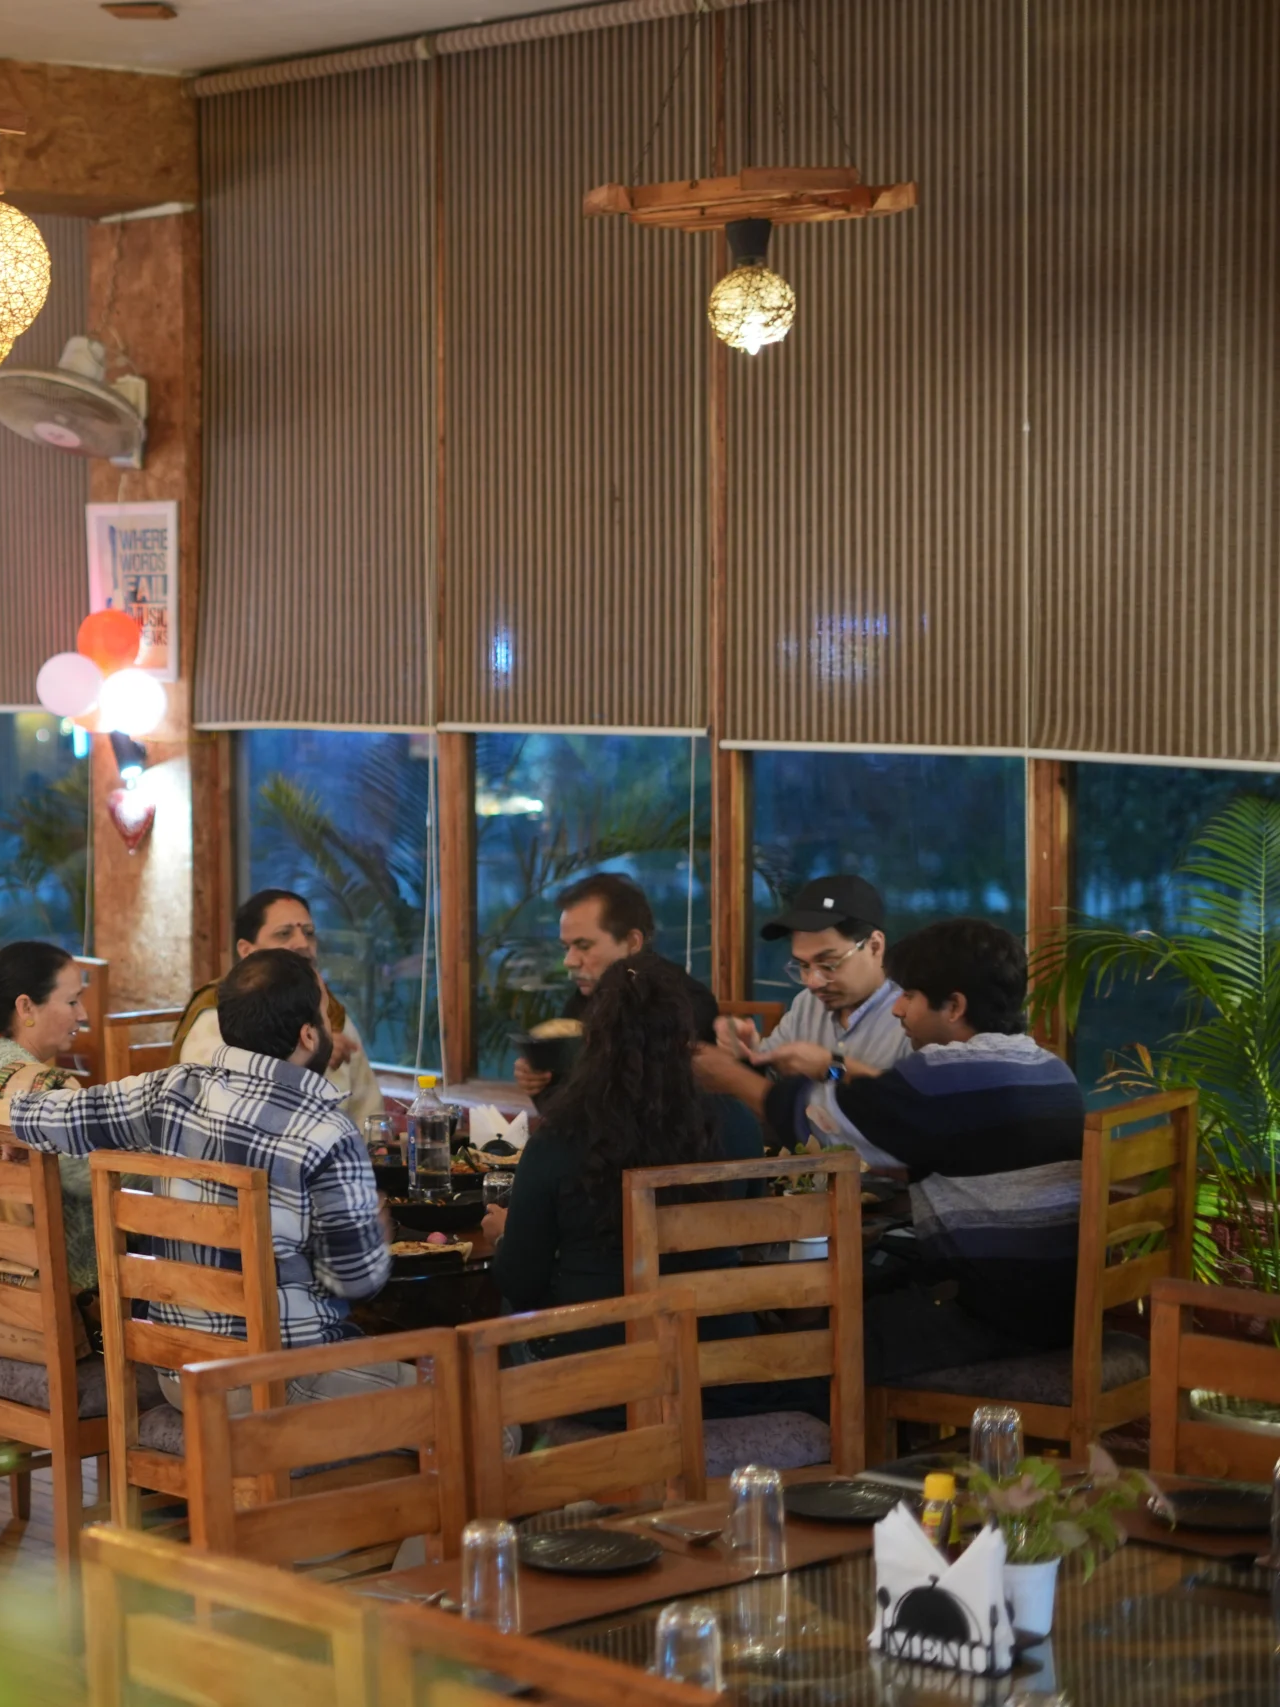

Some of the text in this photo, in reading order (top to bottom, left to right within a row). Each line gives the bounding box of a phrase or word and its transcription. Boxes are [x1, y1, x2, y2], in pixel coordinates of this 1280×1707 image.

[119, 528, 168, 550] WHERE
[121, 552, 166, 572] WORDS
[124, 575, 168, 603] FAIL
[883, 1629, 988, 1674] MENU
